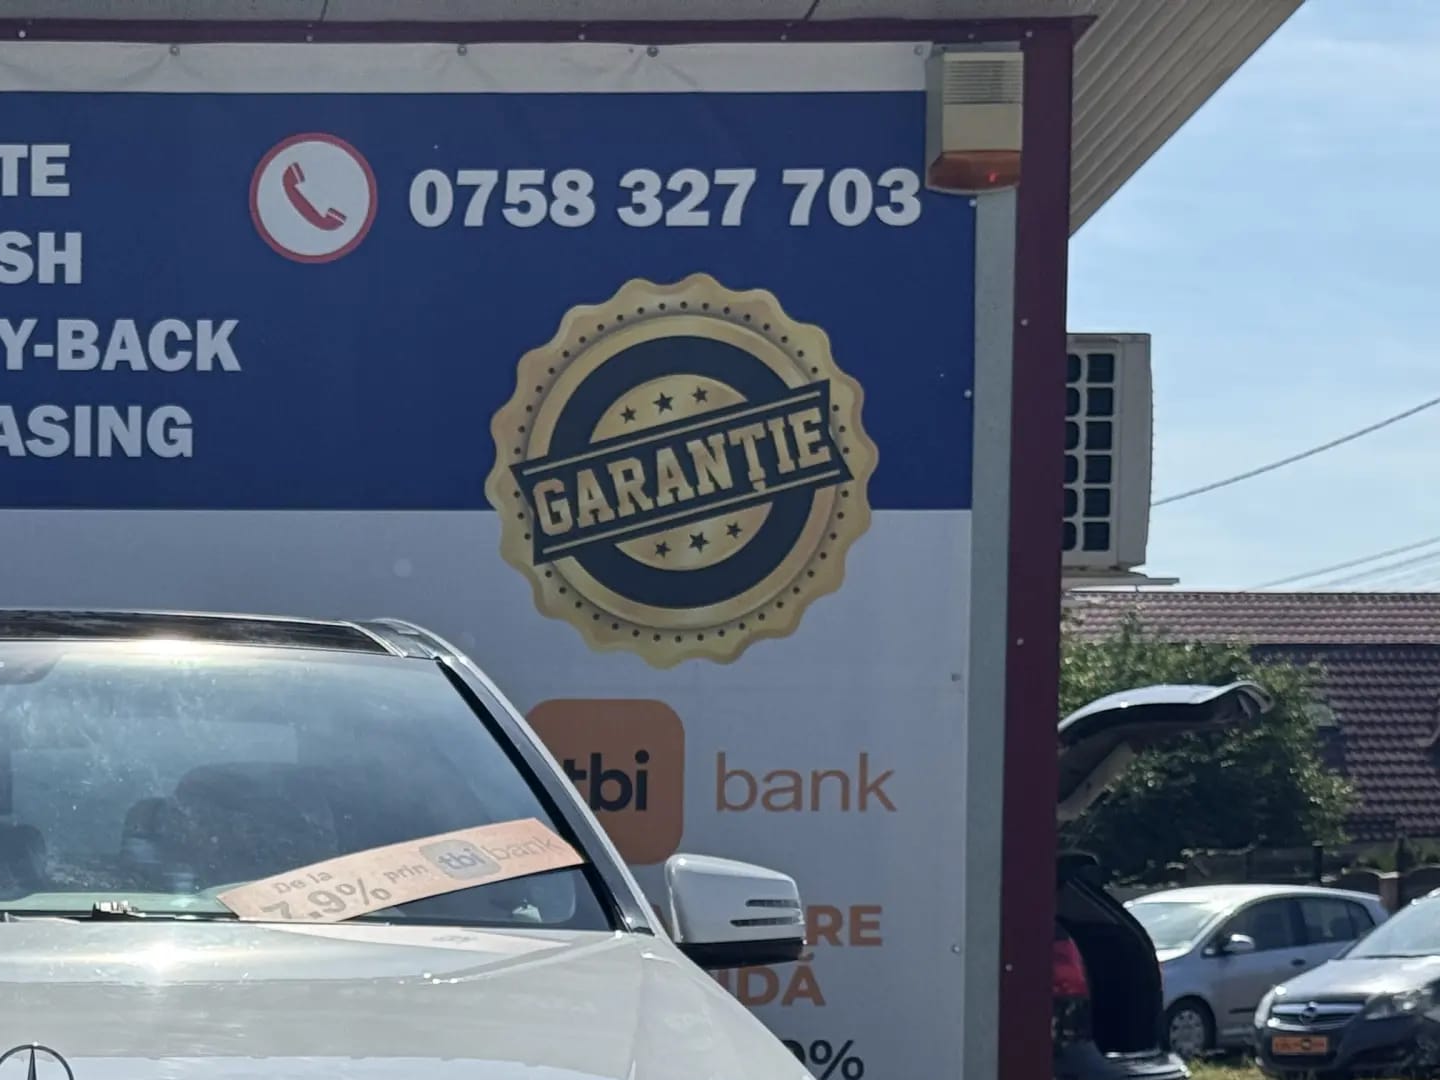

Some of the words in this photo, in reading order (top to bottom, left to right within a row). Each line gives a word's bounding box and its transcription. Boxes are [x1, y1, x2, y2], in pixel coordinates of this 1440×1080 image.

[409, 169, 595, 227] 0758
[617, 169, 756, 227] 327
[782, 168, 921, 227] 703
[715, 751, 897, 813] bank
[384, 860, 430, 885] prin
[437, 846, 486, 871] tbi
[482, 834, 558, 861] bank
